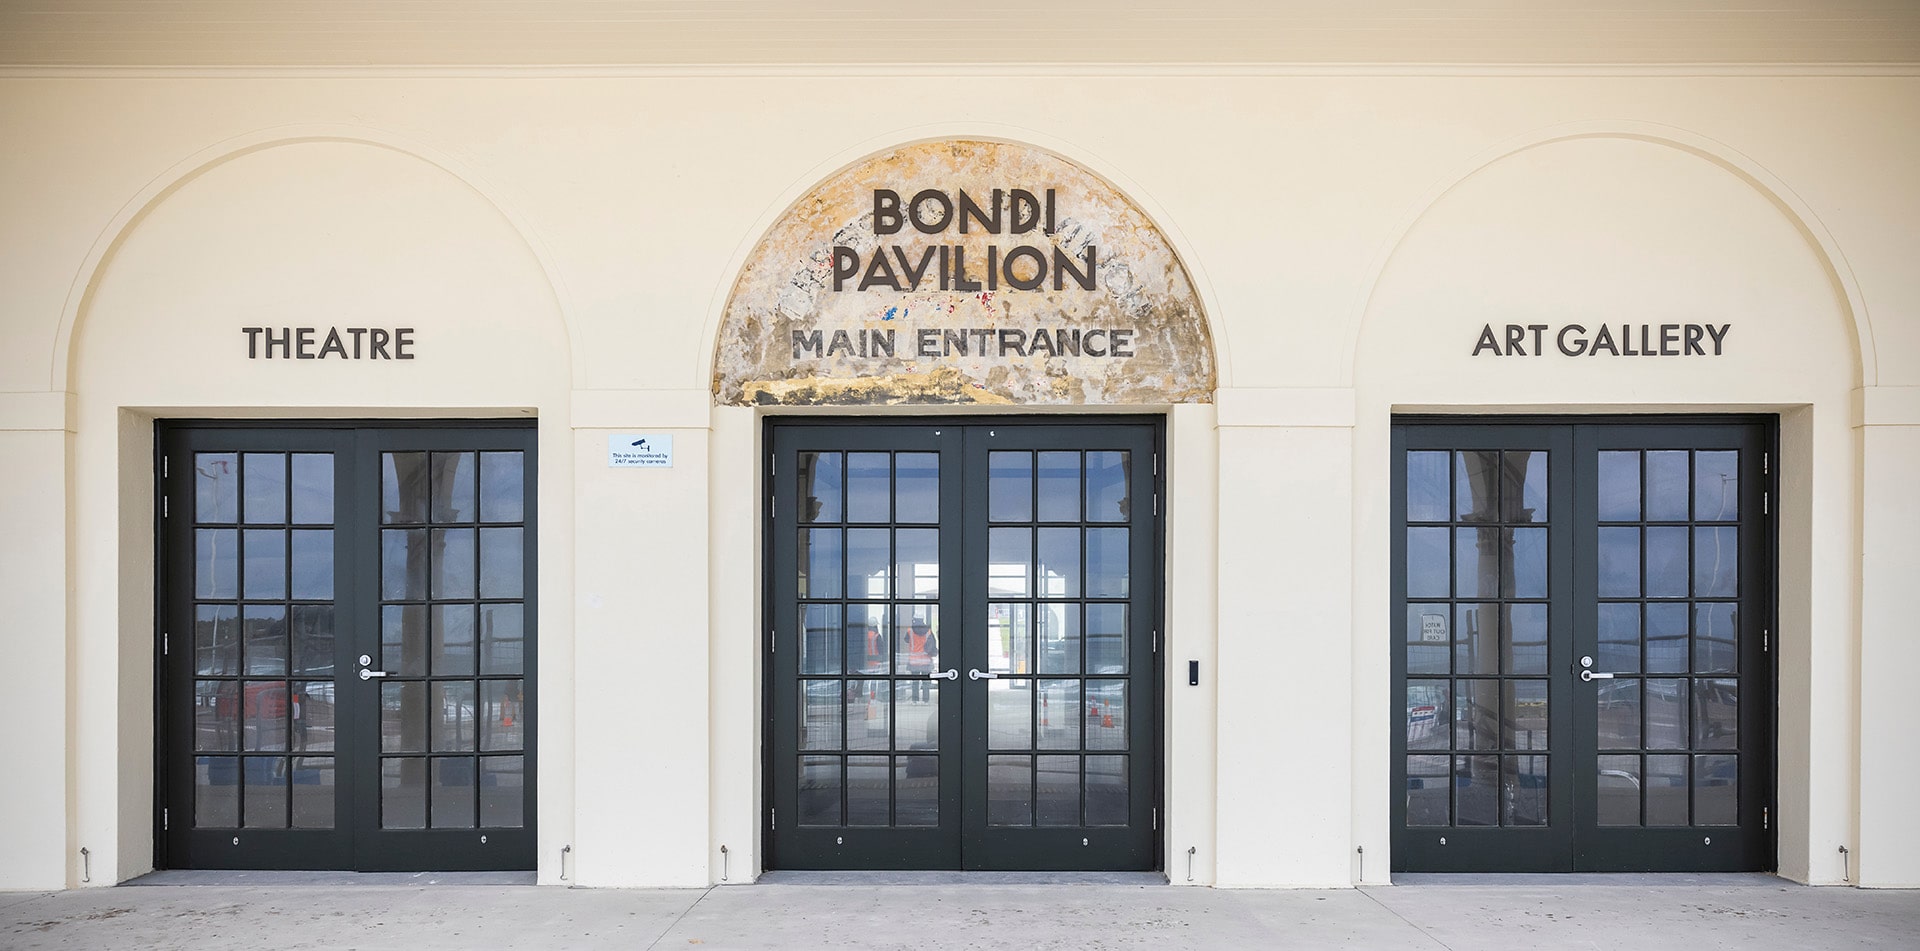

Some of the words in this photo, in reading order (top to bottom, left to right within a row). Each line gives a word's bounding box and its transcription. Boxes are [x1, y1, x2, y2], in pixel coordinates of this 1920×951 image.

[873, 188, 1056, 235] BONDI
[832, 245, 1097, 292] PAVILION
[241, 326, 416, 360] THEATRE
[792, 328, 896, 359] MAIN
[917, 328, 1134, 359] ENTRANCE
[1472, 323, 1549, 357] ART
[1556, 323, 1731, 357] GALLERY
